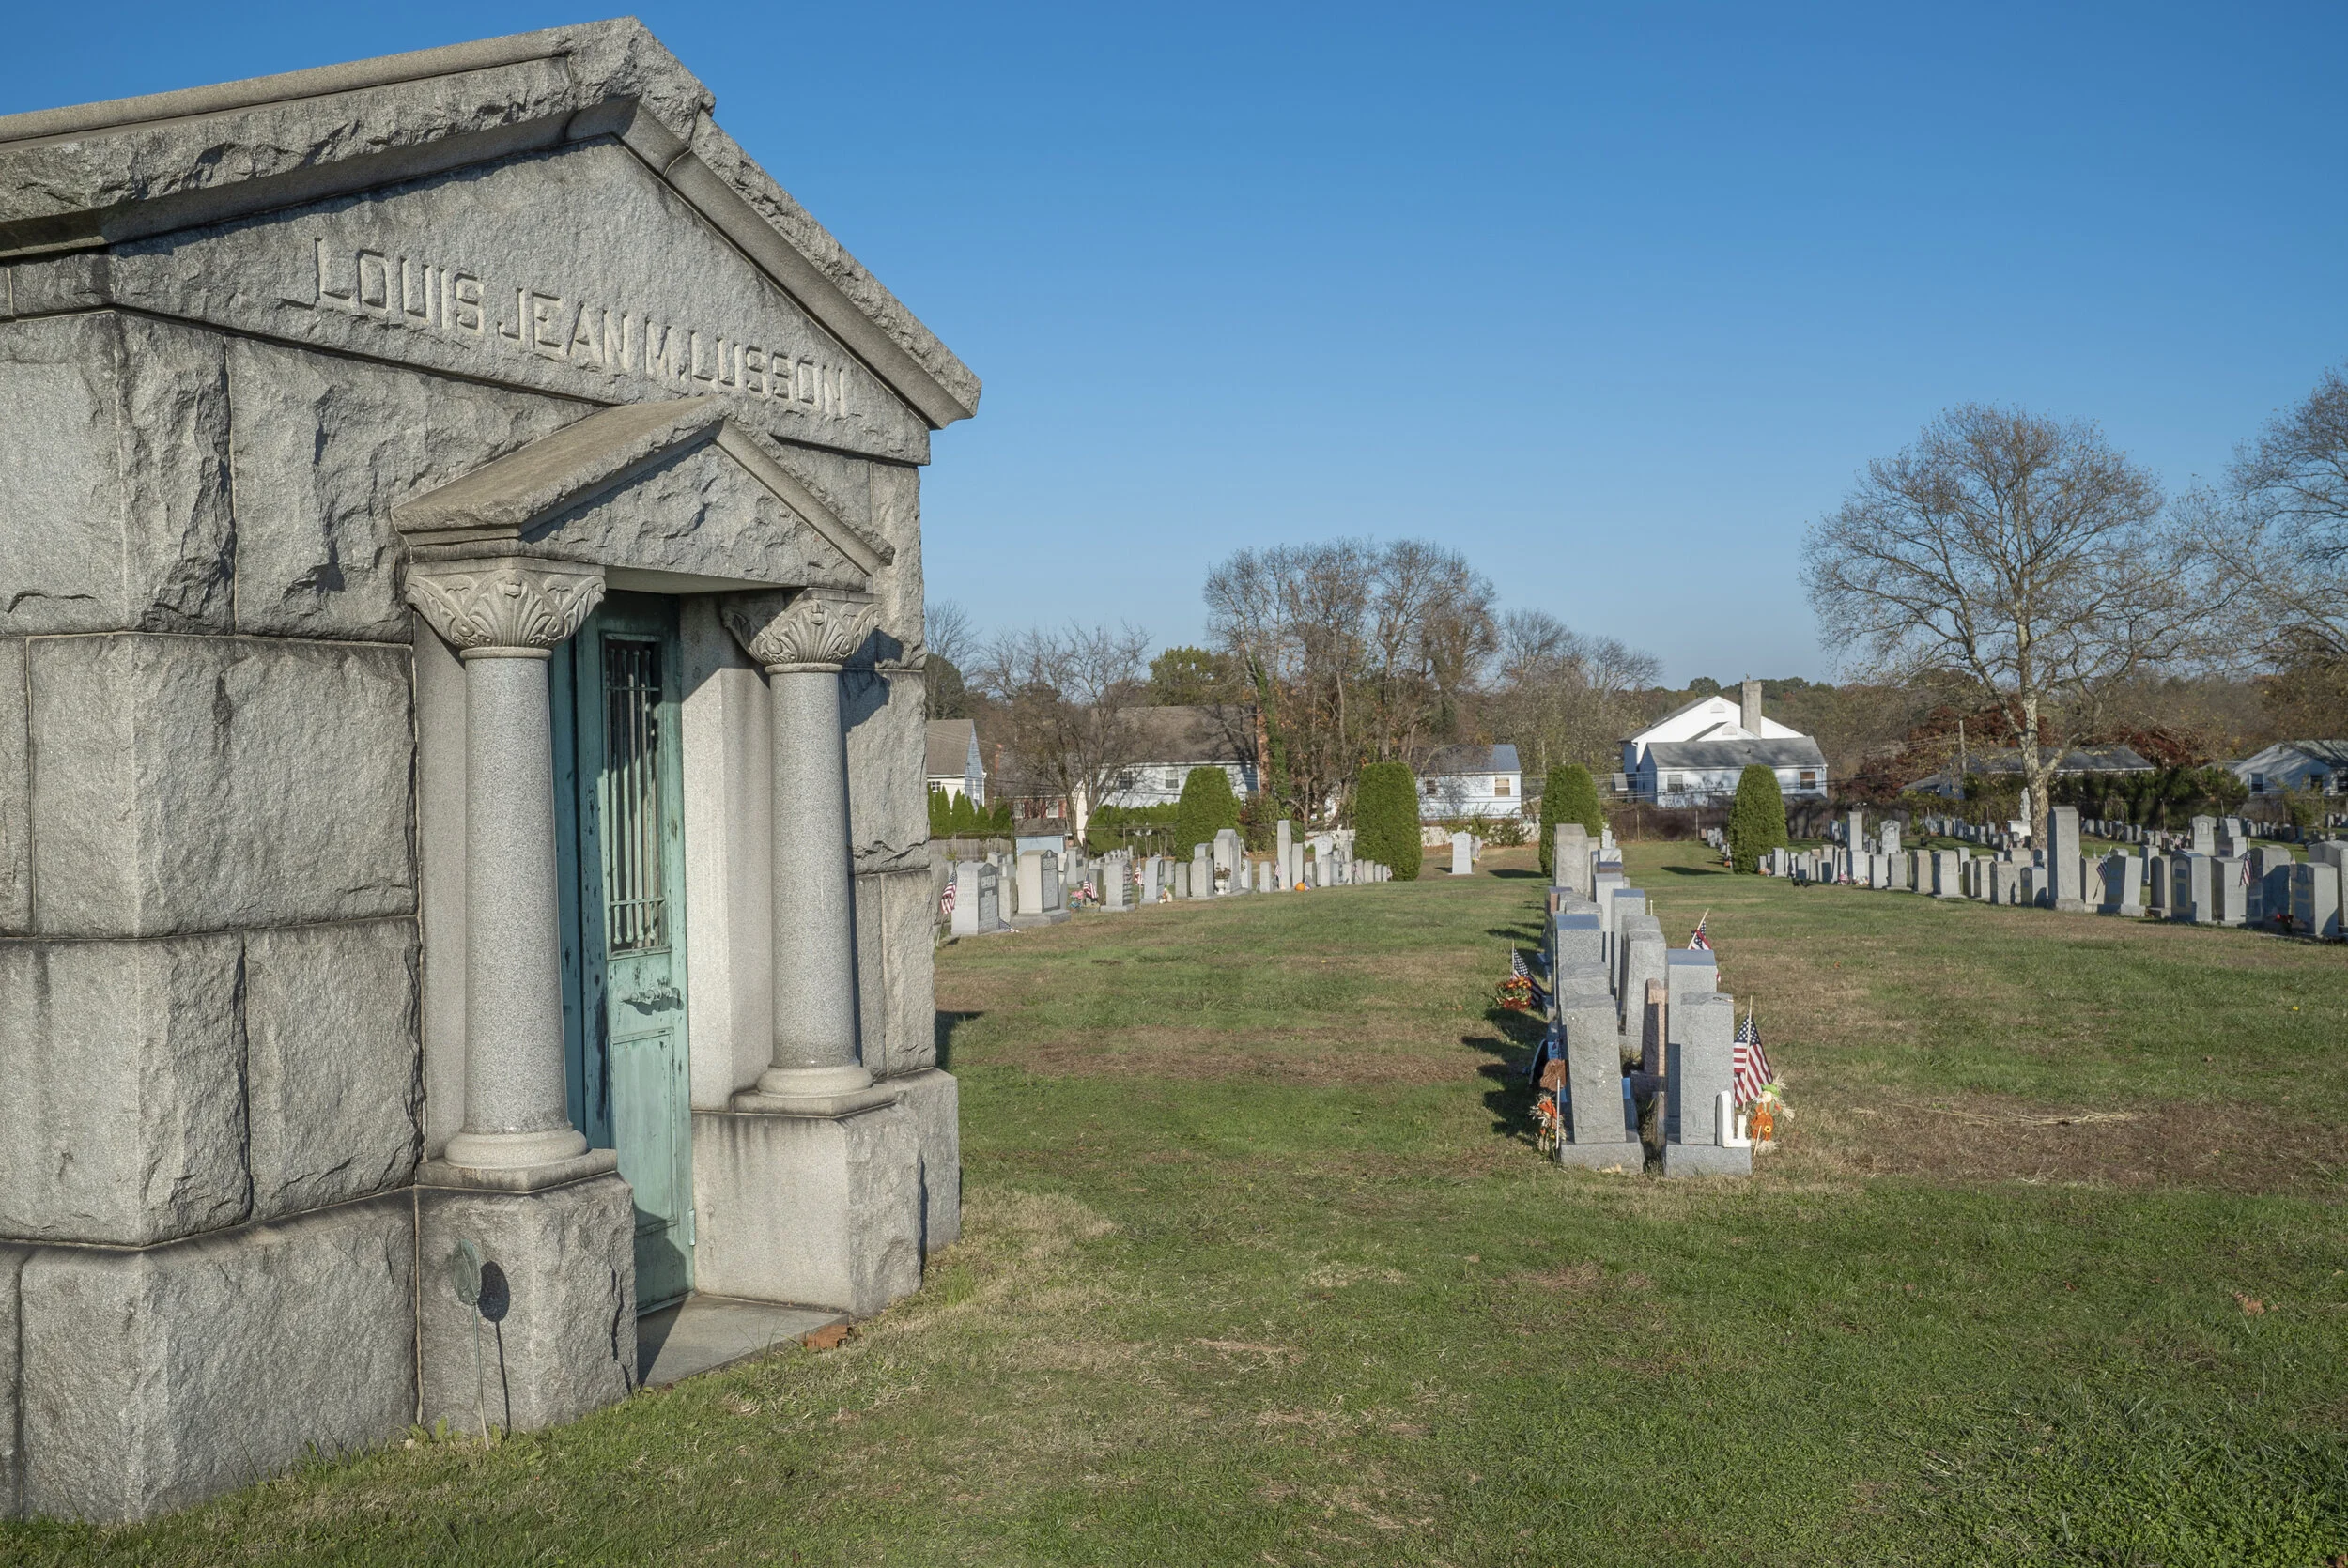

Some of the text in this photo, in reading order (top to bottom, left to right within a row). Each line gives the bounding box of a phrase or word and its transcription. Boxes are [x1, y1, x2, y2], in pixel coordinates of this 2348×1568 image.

[315, 237, 485, 336] LOUIS
[497, 287, 631, 370] JEAN
[690, 330, 845, 417] LUSSON
